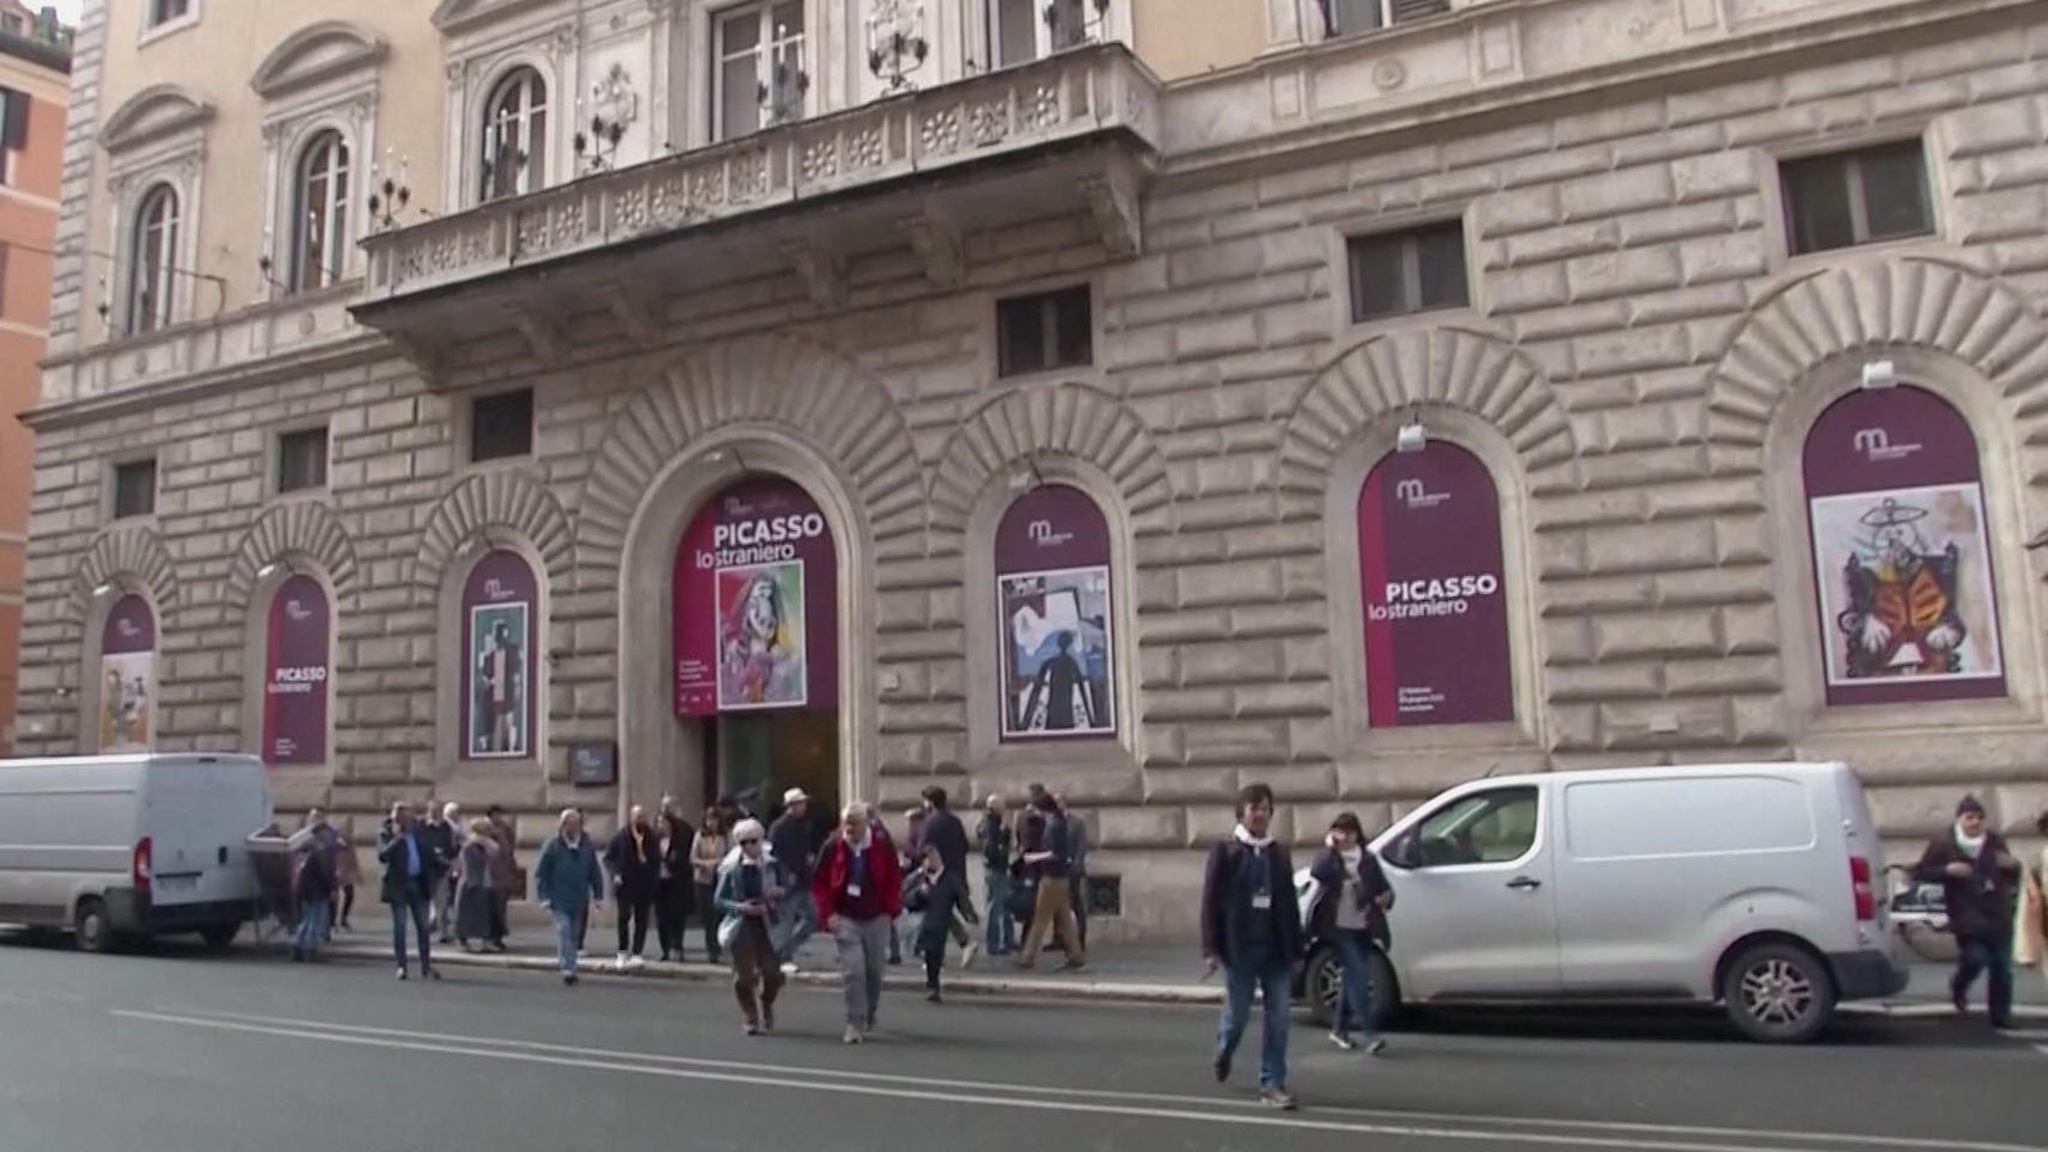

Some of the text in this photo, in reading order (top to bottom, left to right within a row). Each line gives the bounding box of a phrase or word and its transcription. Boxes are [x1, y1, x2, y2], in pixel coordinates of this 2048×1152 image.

[714, 513, 824, 548] PICASSO
[1386, 574, 1498, 603] PICASSO
[275, 666, 327, 682] PICASSO
